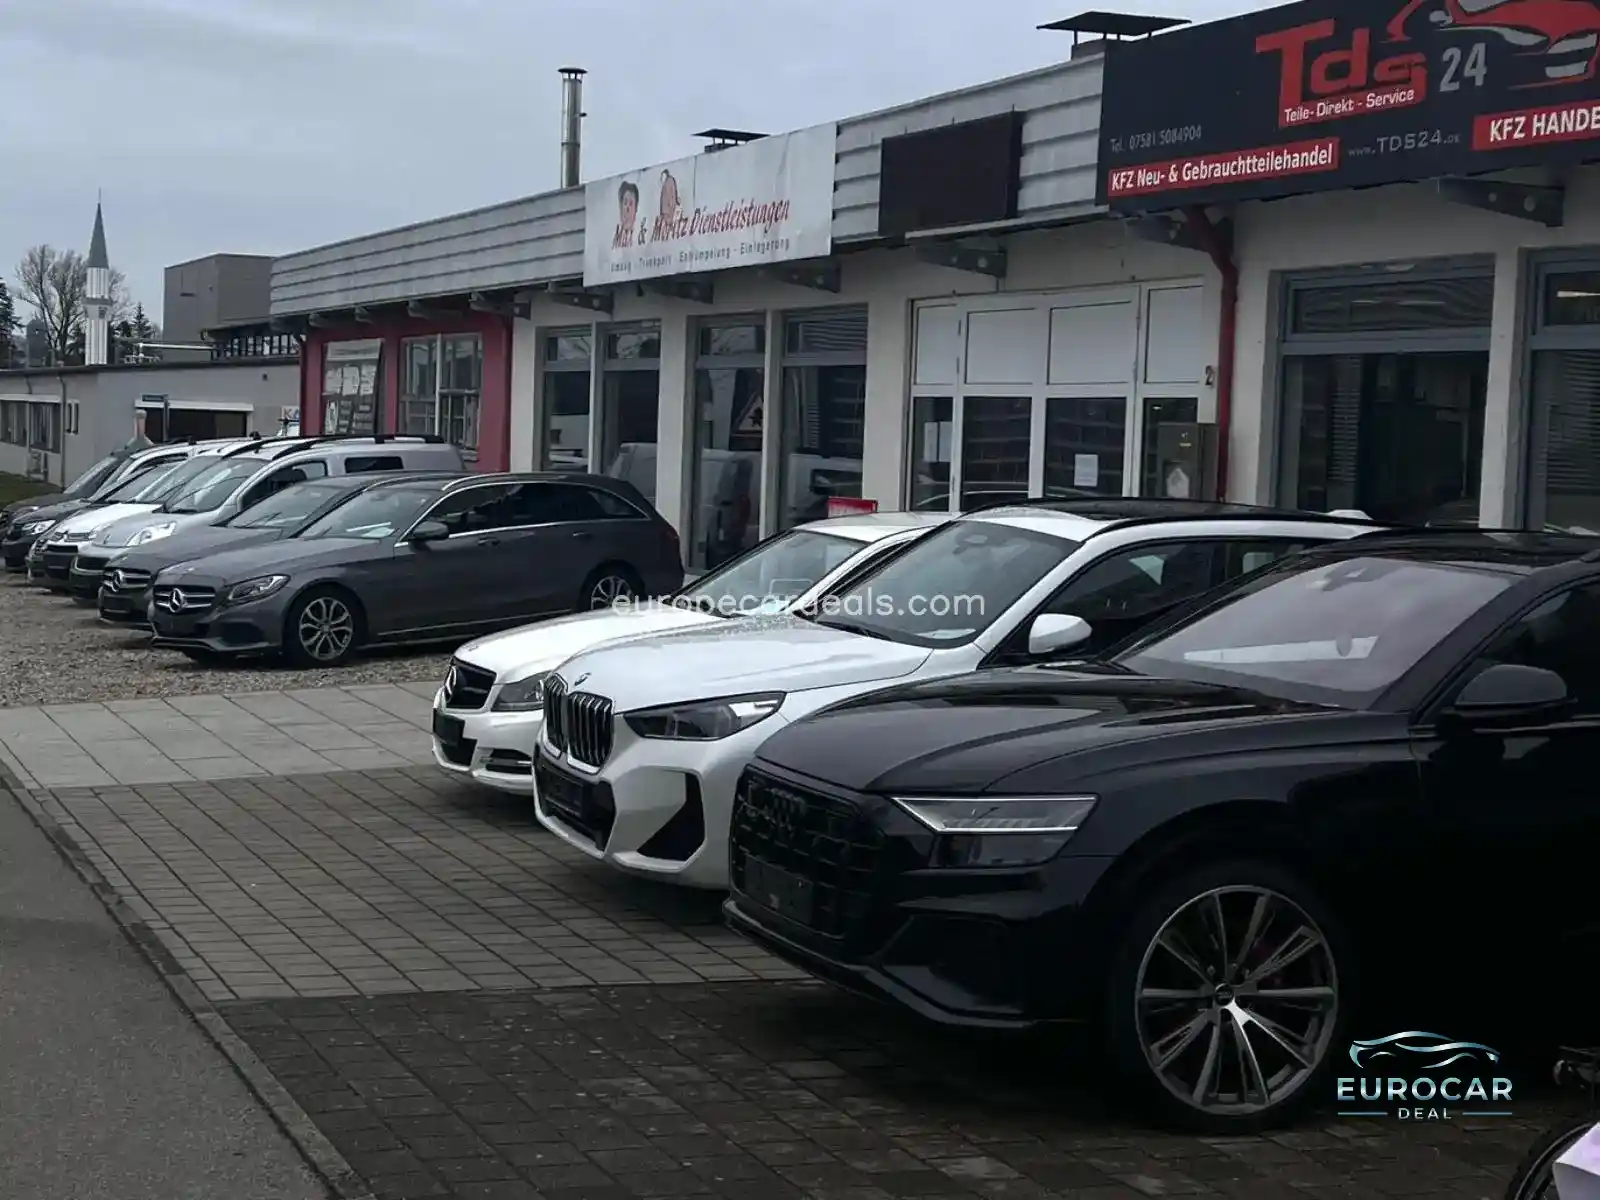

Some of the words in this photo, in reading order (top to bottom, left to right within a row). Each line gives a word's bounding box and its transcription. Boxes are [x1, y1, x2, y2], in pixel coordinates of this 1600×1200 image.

[1439, 42, 1488, 93] 24
[1284, 107, 1315, 123] Teile-
[1316, 99, 1354, 118] Direkt
[1365, 88, 1416, 109] Service
[1489, 115, 1527, 143] KFZ
[1111, 170, 1135, 191] KFZ
[1137, 167, 1166, 188] Neu-
[1168, 164, 1179, 183] &
[1182, 143, 1334, 182] Gebrauchtteilehandel
[637, 216, 648, 246] &
[688, 198, 790, 236] Dienstleistungen
[1203, 364, 1216, 387] 2
